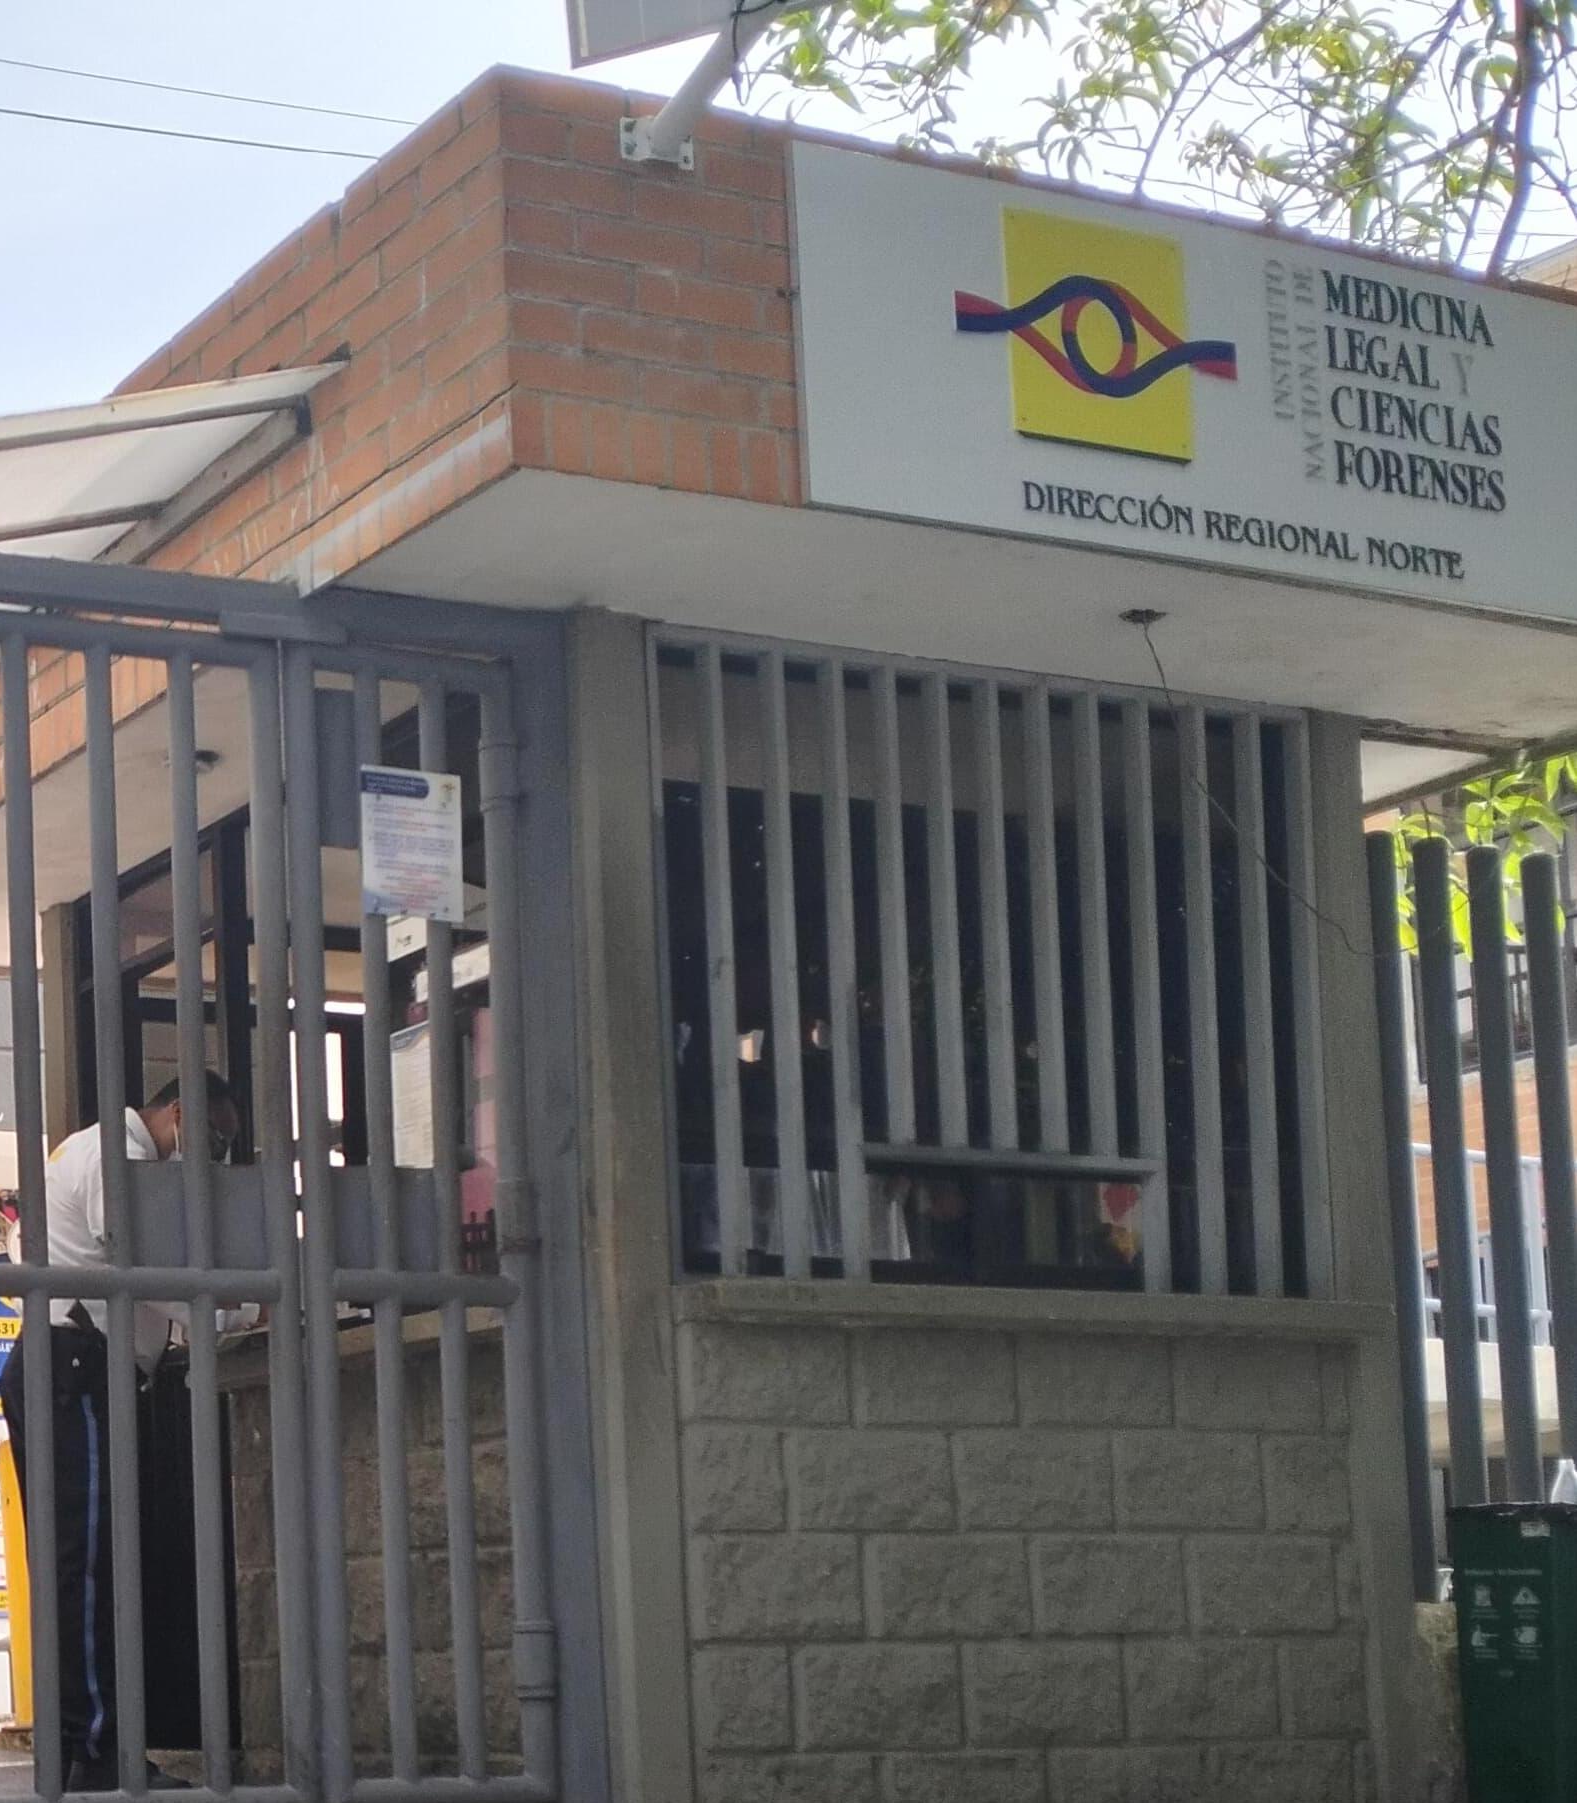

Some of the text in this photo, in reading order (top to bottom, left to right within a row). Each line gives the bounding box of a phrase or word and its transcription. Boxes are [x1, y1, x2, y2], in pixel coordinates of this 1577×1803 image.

[1321, 269, 1495, 347] MEDICINA
[1324, 324, 1475, 395] LEGAL Y
[1331, 385, 1503, 456] CIENCIAS
[1334, 440, 1507, 512] FORENSES
[1022, 480, 1465, 580] DIRECCIÓN REGIONAL NORTE
